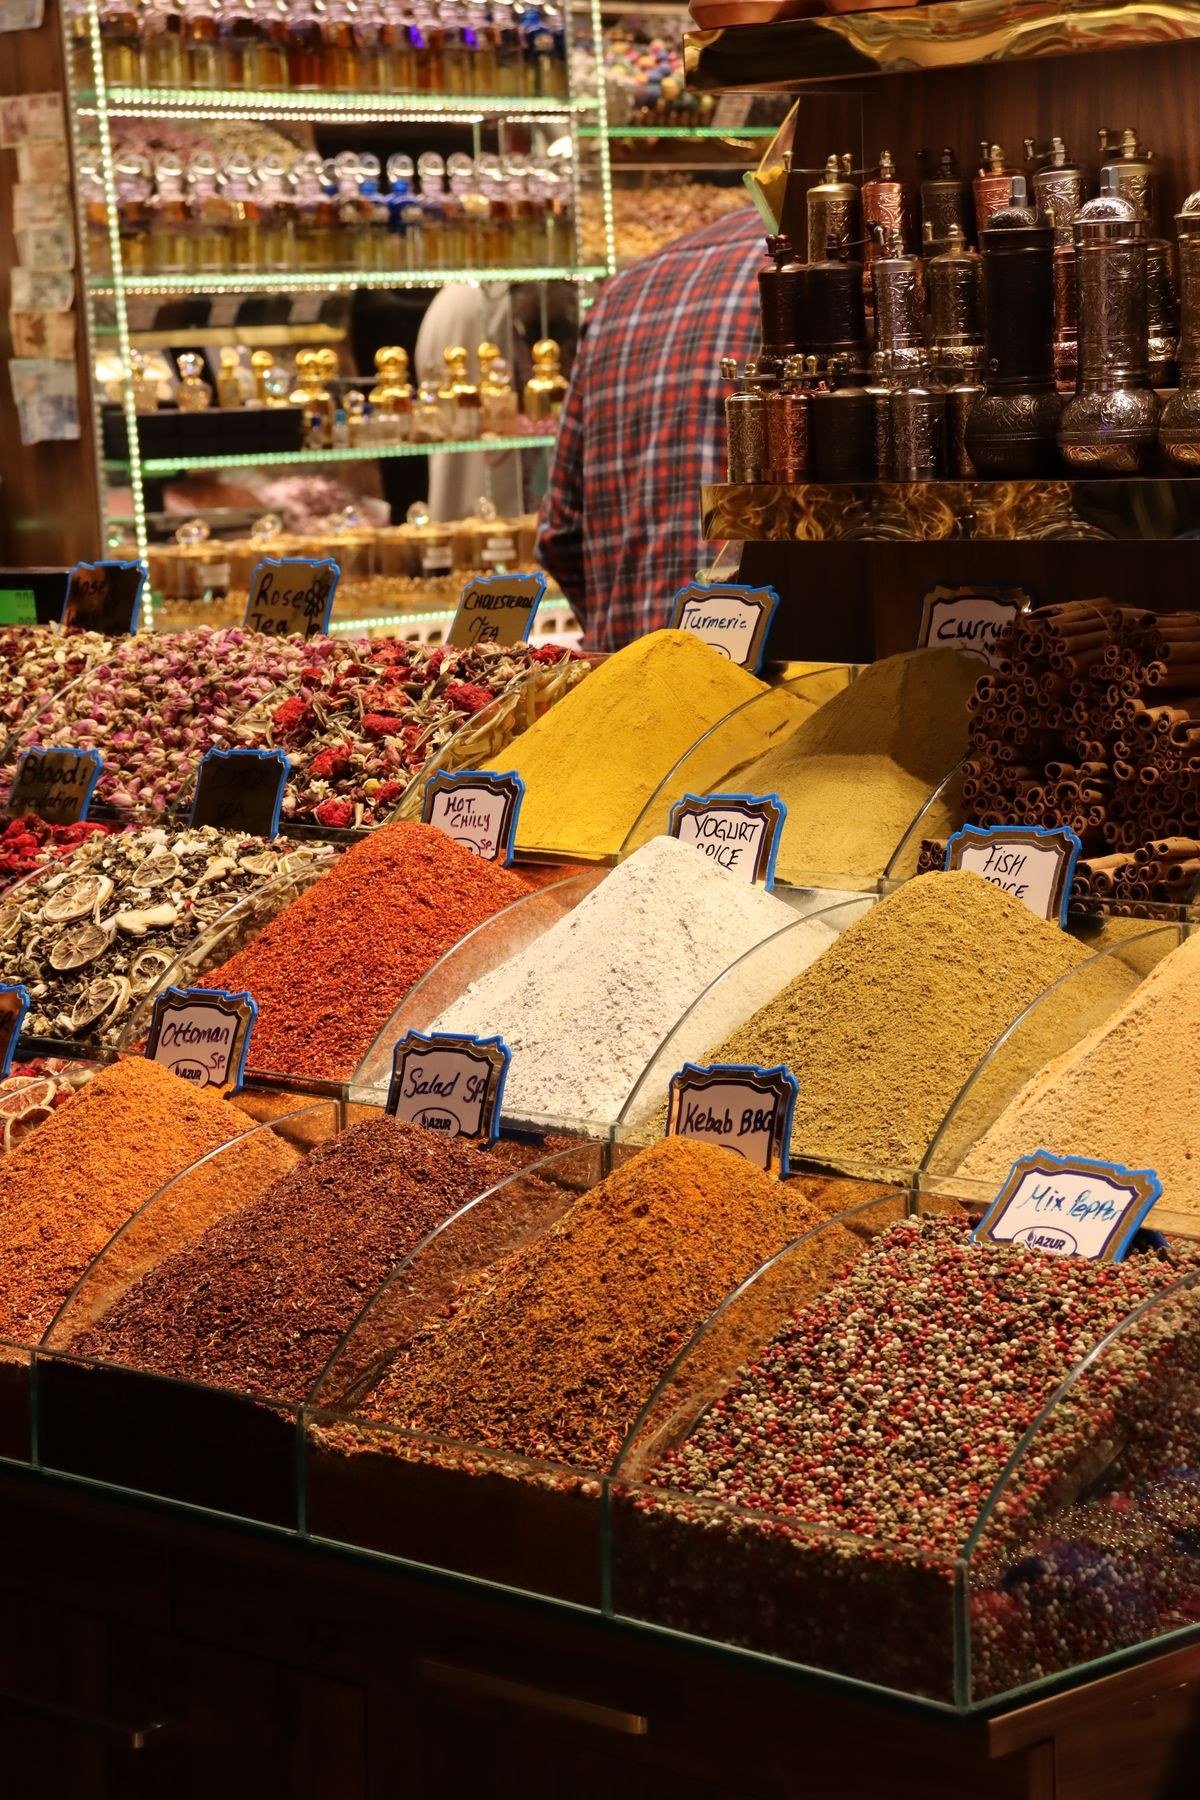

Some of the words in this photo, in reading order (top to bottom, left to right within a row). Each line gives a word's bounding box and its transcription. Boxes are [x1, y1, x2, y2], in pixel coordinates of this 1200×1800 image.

[685, 608, 747, 630] Turmeric
[694, 815, 760, 842] YOGURT
[161, 1021, 230, 1047] Ottoman
[403, 1067, 461, 1098] Salad
[428, 1114, 452, 1130] AZUR
[681, 1102, 733, 1135] Kebab
[1016, 1184, 1066, 1212] Mix
[1035, 1235, 1066, 1251] AZUR
